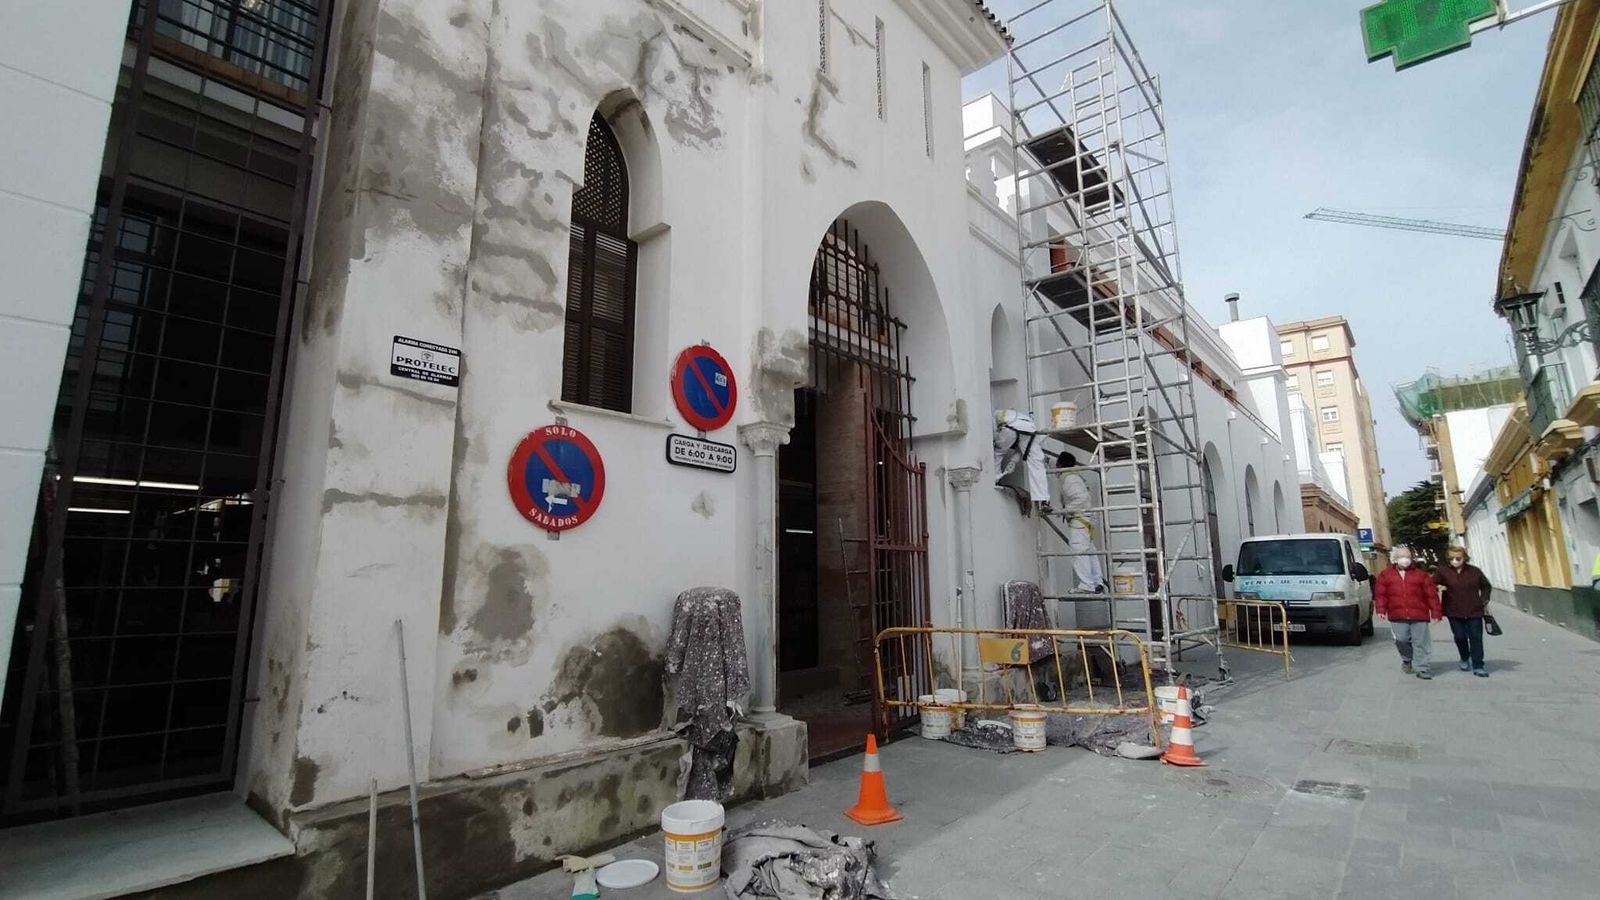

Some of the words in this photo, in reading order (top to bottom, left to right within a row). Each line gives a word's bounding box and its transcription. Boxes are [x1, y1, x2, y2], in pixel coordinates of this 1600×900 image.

[420, 342, 448, 352] CONECTADA
[396, 355, 456, 374] PROTELEC
[545, 425, 577, 438] SOLO
[674, 438, 695, 449] CARGA
[702, 443, 733, 455] DESCARGA
[674, 446, 686, 456] DE
[708, 453, 714, 461] A
[528, 507, 579, 527] SALADOS
[1360, 530, 1368, 539] P
[1010, 641, 1025, 662] 6
